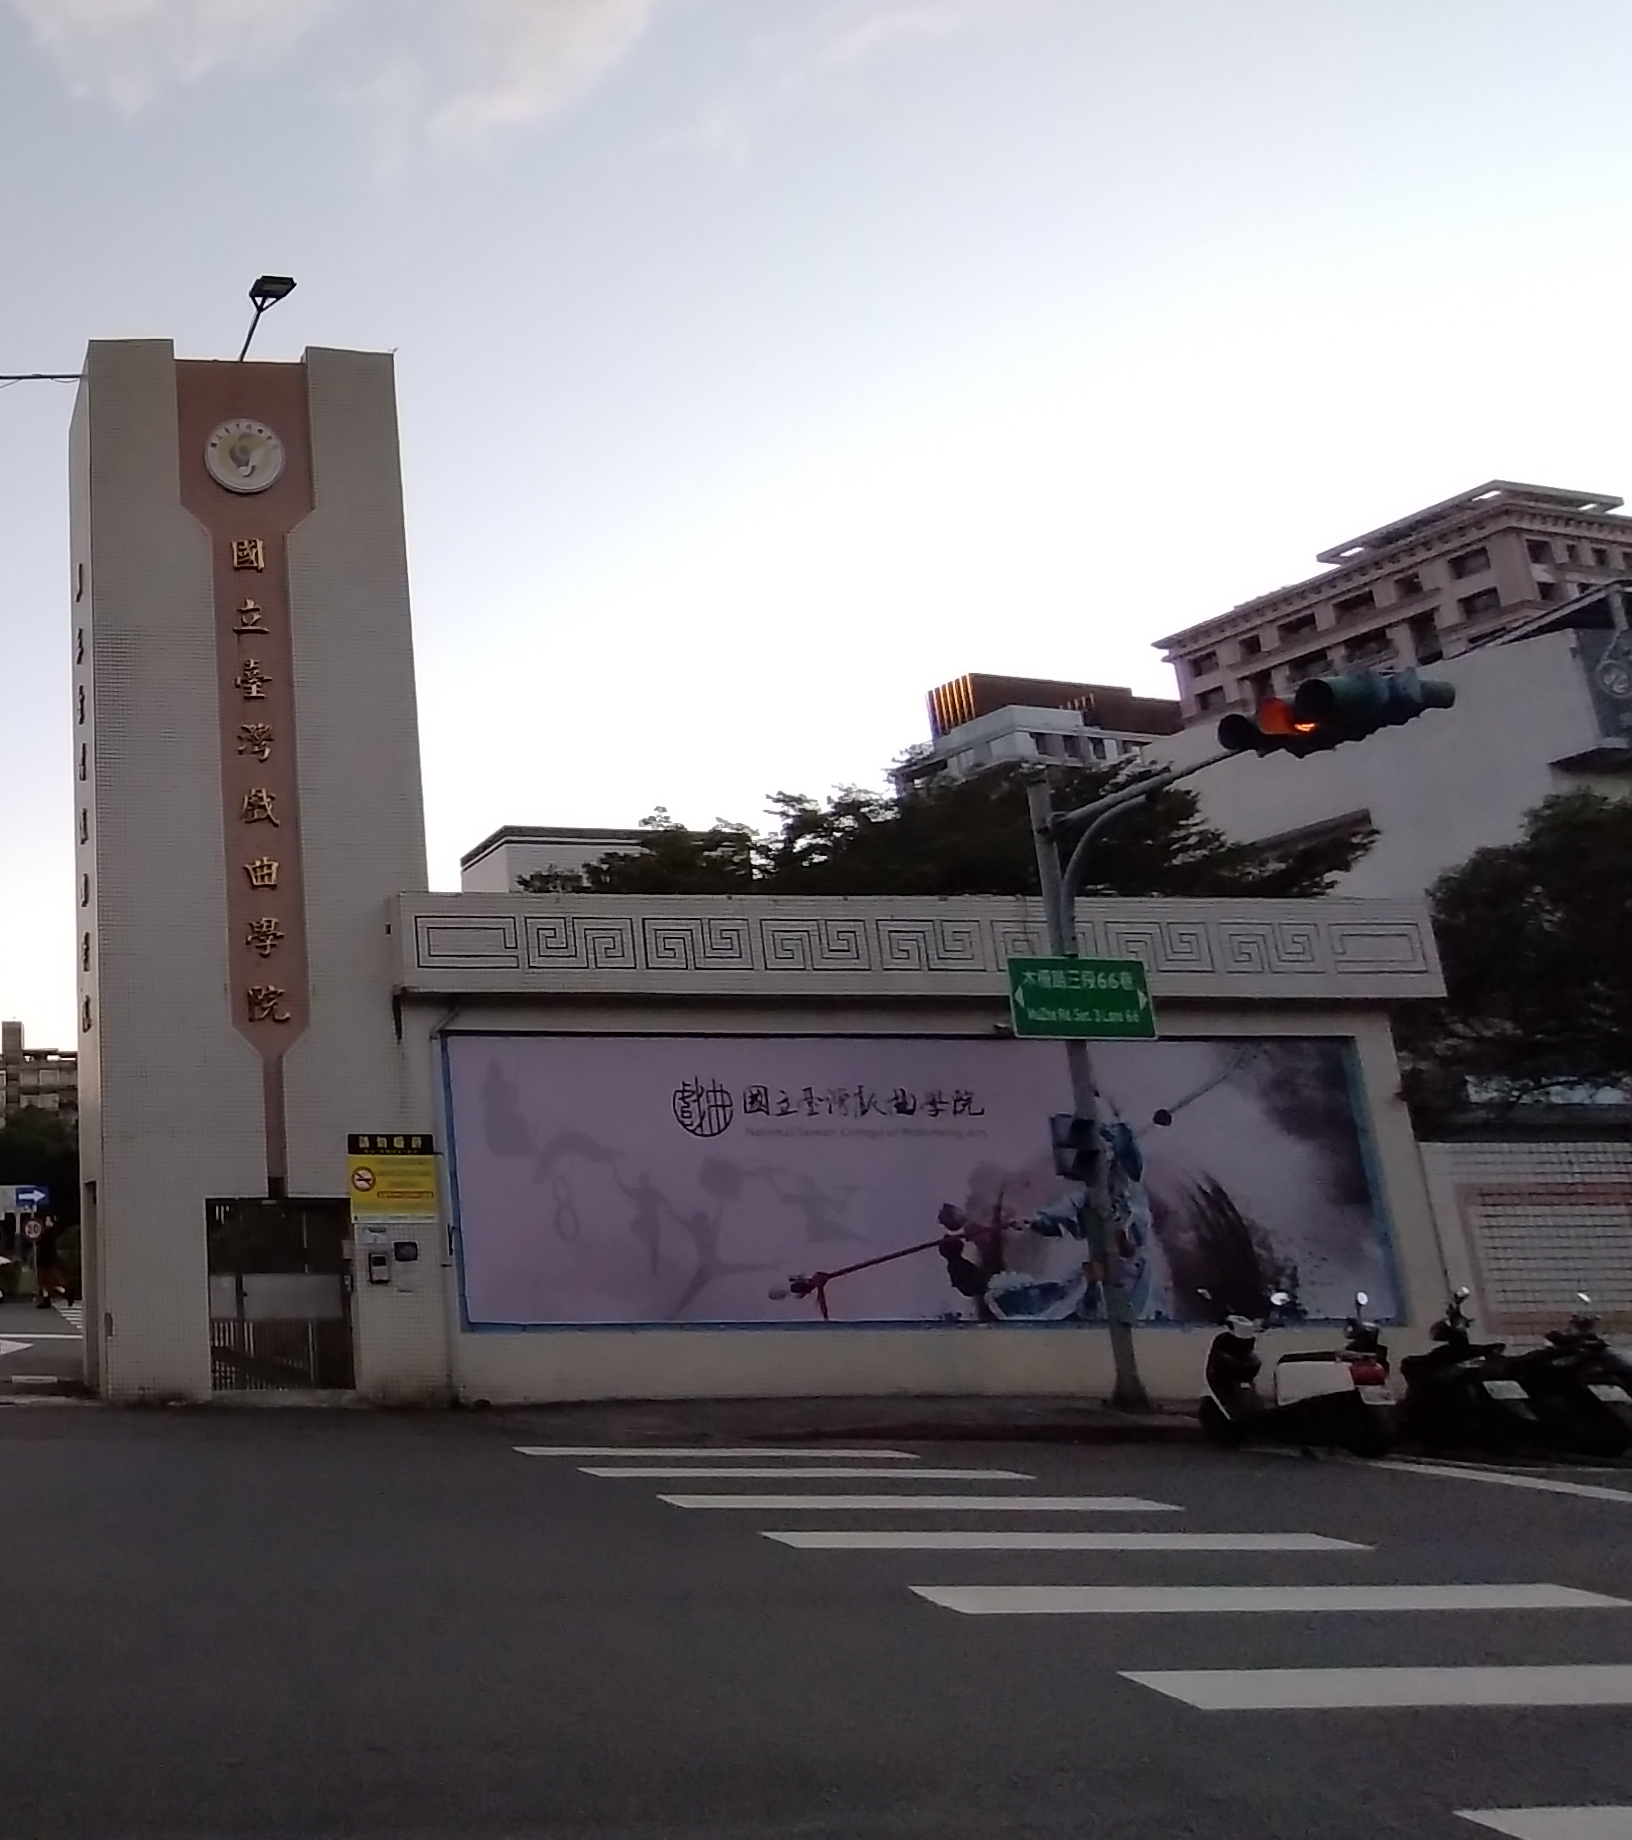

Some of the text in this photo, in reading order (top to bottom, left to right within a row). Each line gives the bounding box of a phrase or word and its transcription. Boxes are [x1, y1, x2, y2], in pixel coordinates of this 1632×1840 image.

[230, 537, 291, 1024] 國立臺灣戲曲學院
